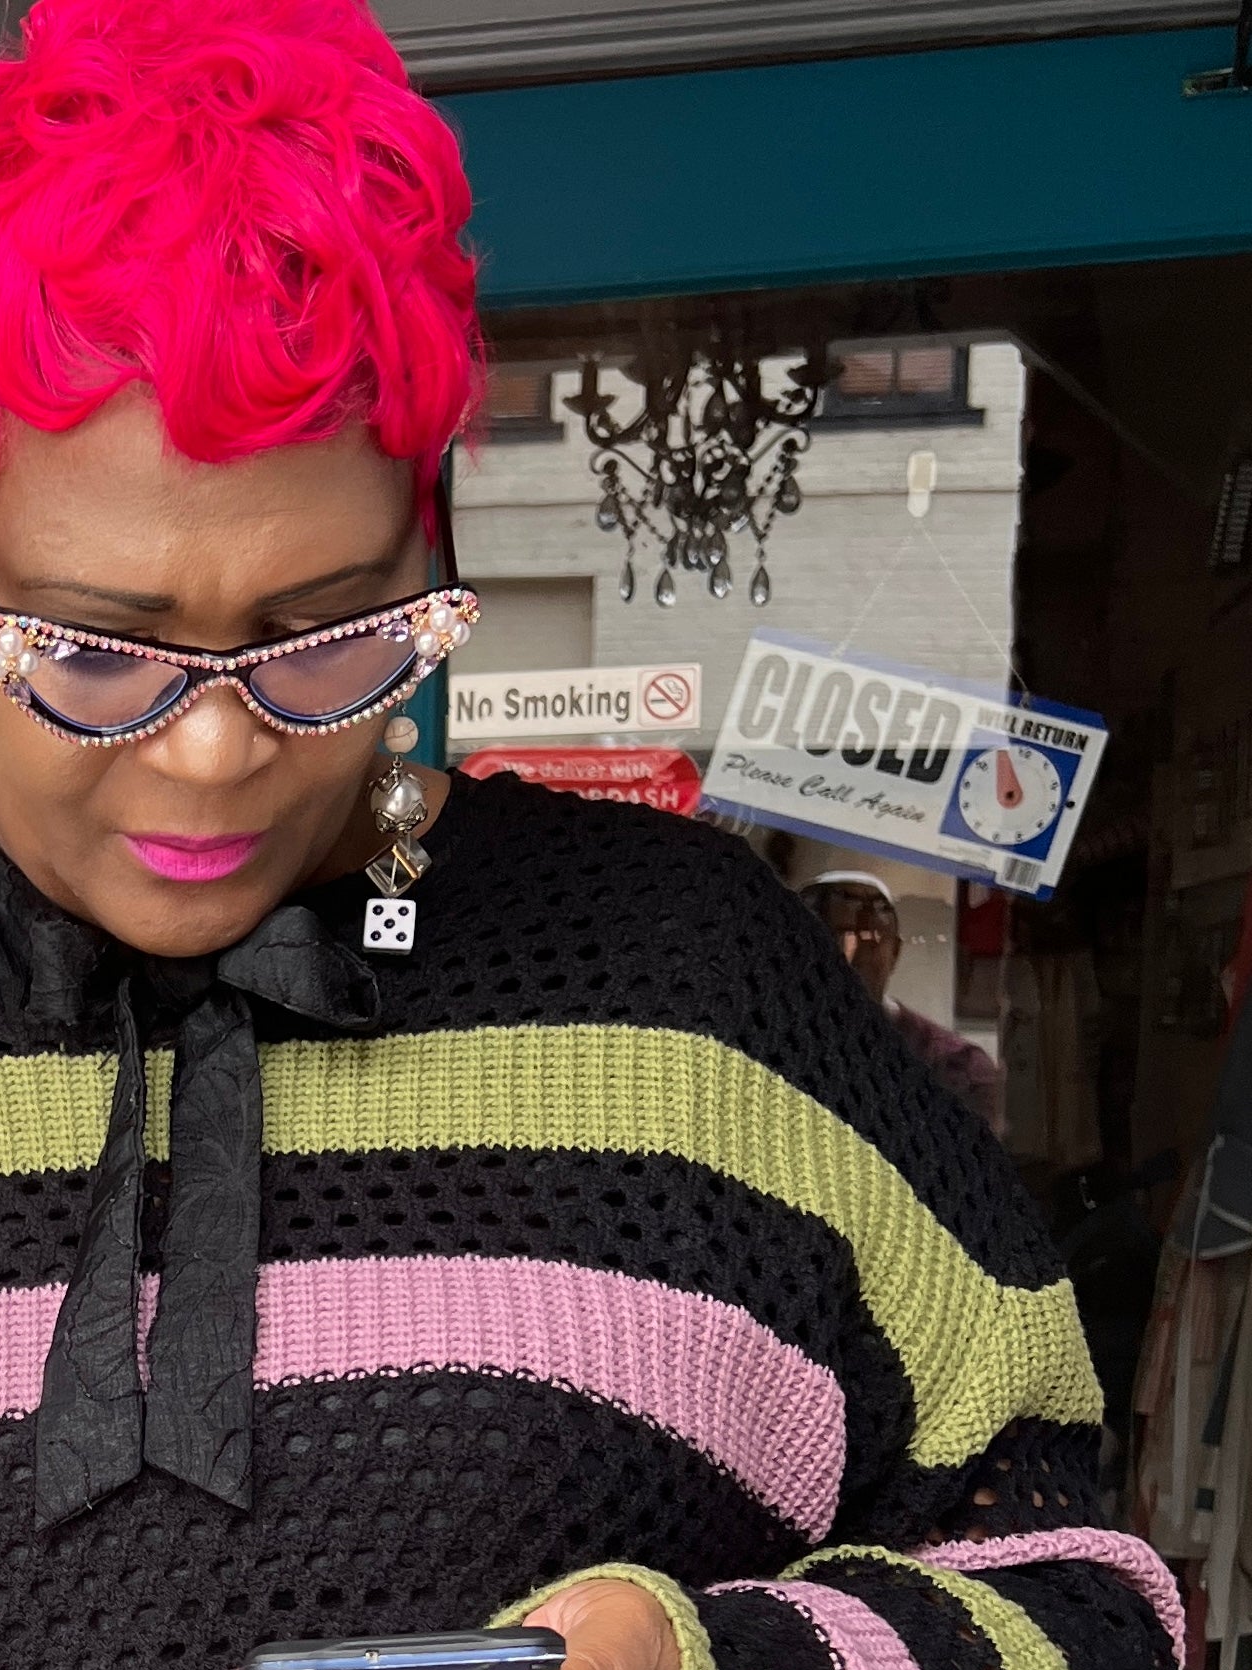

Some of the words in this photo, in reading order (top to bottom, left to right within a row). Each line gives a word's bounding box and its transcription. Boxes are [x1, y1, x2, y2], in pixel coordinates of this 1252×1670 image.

[456, 690, 493, 721] No
[504, 683, 630, 723] Smoking
[738, 654, 961, 785] CLOSED
[1020, 719, 1089, 752] RETURN
[539, 759, 605, 778] deliver
[610, 760, 653, 778] with
[721, 752, 793, 788] Please
[799, 774, 854, 802] Call
[854, 791, 925, 823] Again
